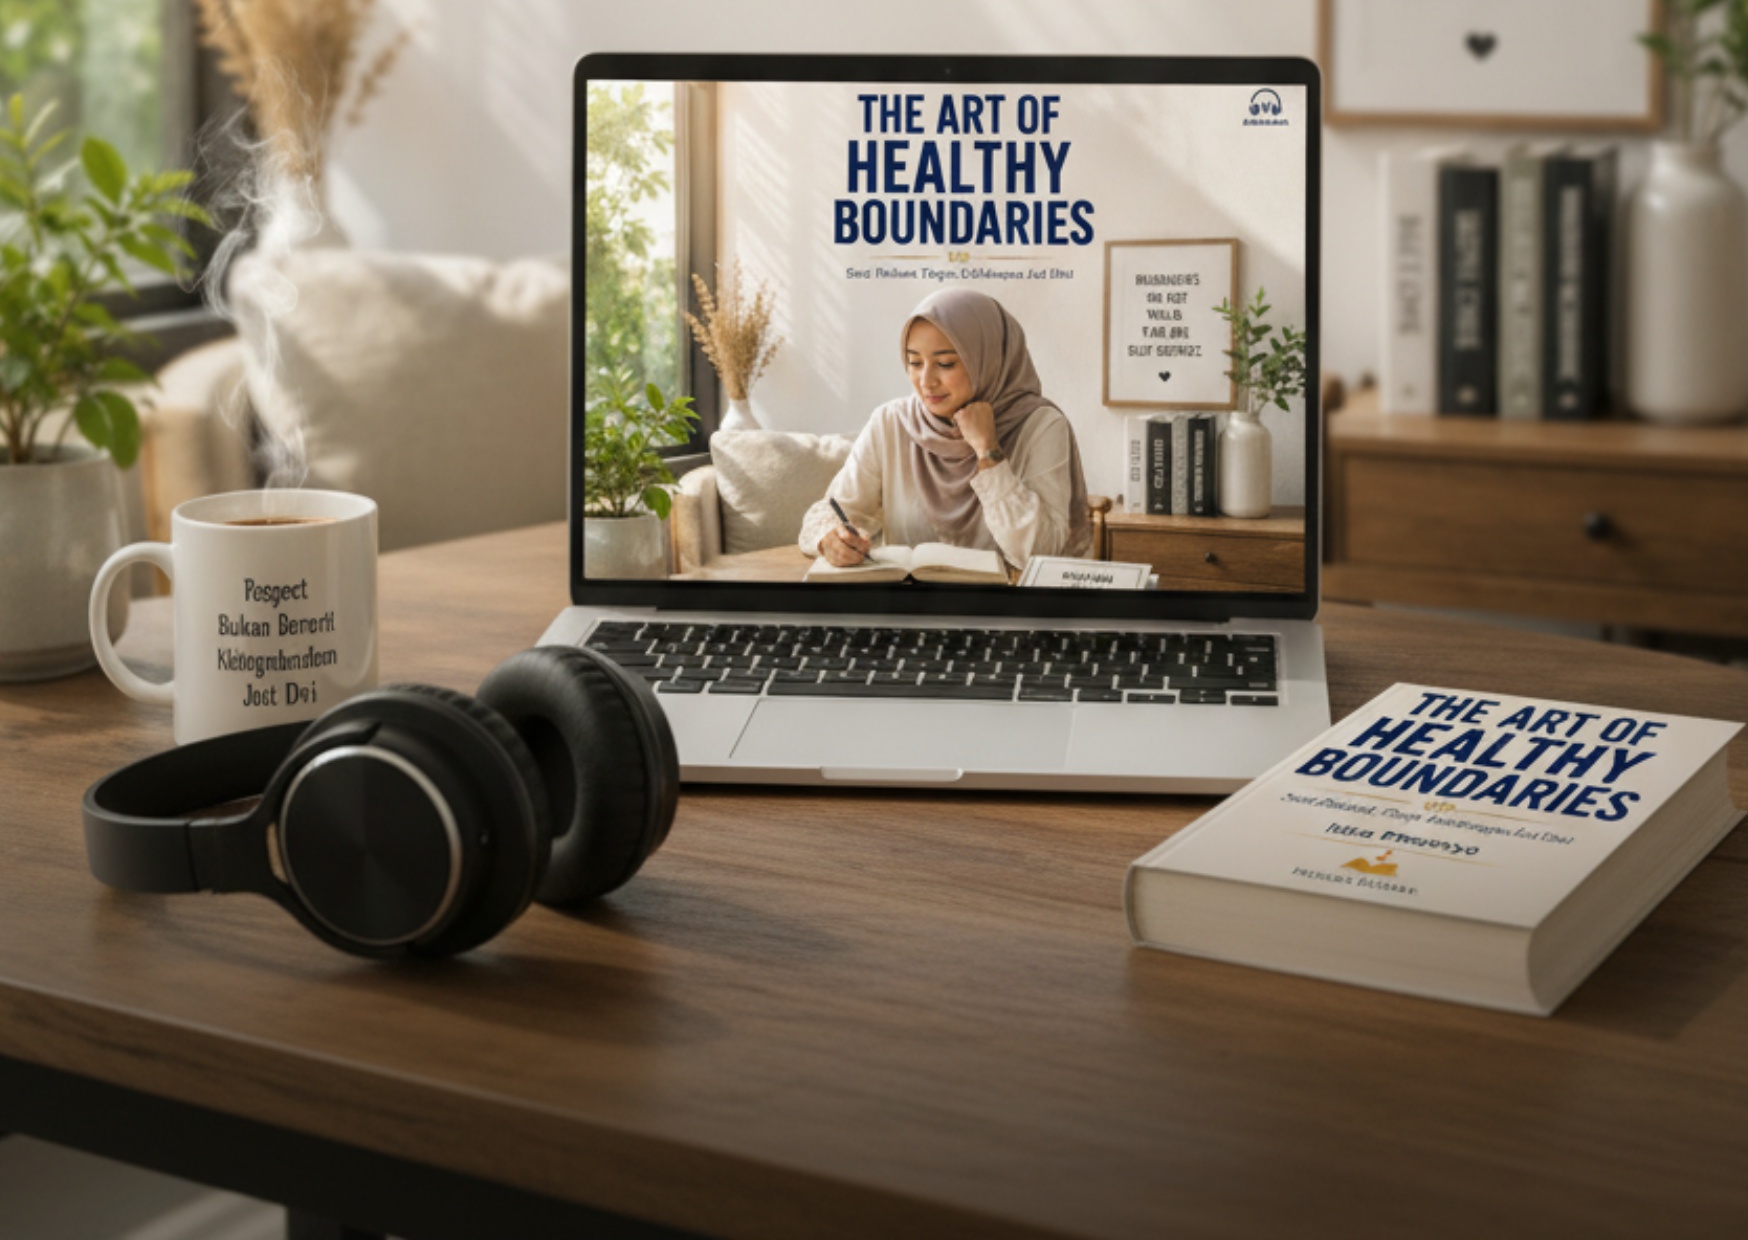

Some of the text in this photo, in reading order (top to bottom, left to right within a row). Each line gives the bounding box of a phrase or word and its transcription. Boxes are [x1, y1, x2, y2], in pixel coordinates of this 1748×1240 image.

[857, 94, 1061, 135] THE ART OF
[847, 140, 1071, 193] HEALTHY
[834, 198, 1095, 245] BOUNDARIES
[1409, 692, 1668, 746] THE ART OF
[1347, 716, 1657, 784] HEALTHY
[1294, 747, 1641, 822] BOUNDARIES
